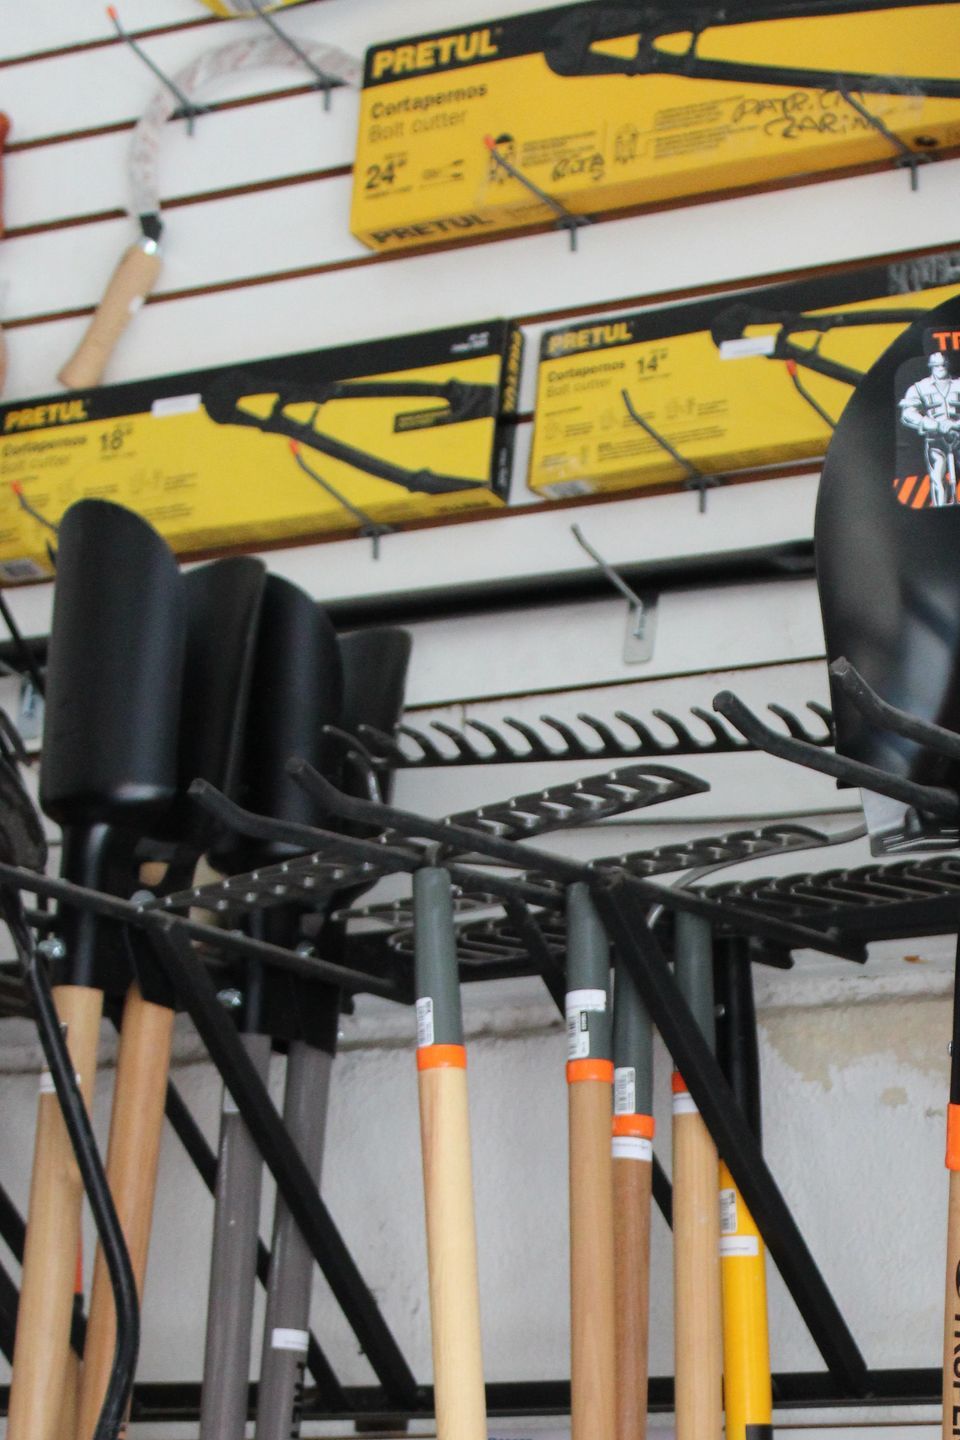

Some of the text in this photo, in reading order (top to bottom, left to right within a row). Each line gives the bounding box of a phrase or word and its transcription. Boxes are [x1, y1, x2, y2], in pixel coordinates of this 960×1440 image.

[371, 29, 498, 79] PRETUL
[371, 84, 488, 119] Cortapernos
[371, 214, 494, 243] PRETUL
[547, 323, 633, 353] PRETUL
[4, 399, 88, 430] PRETUL
